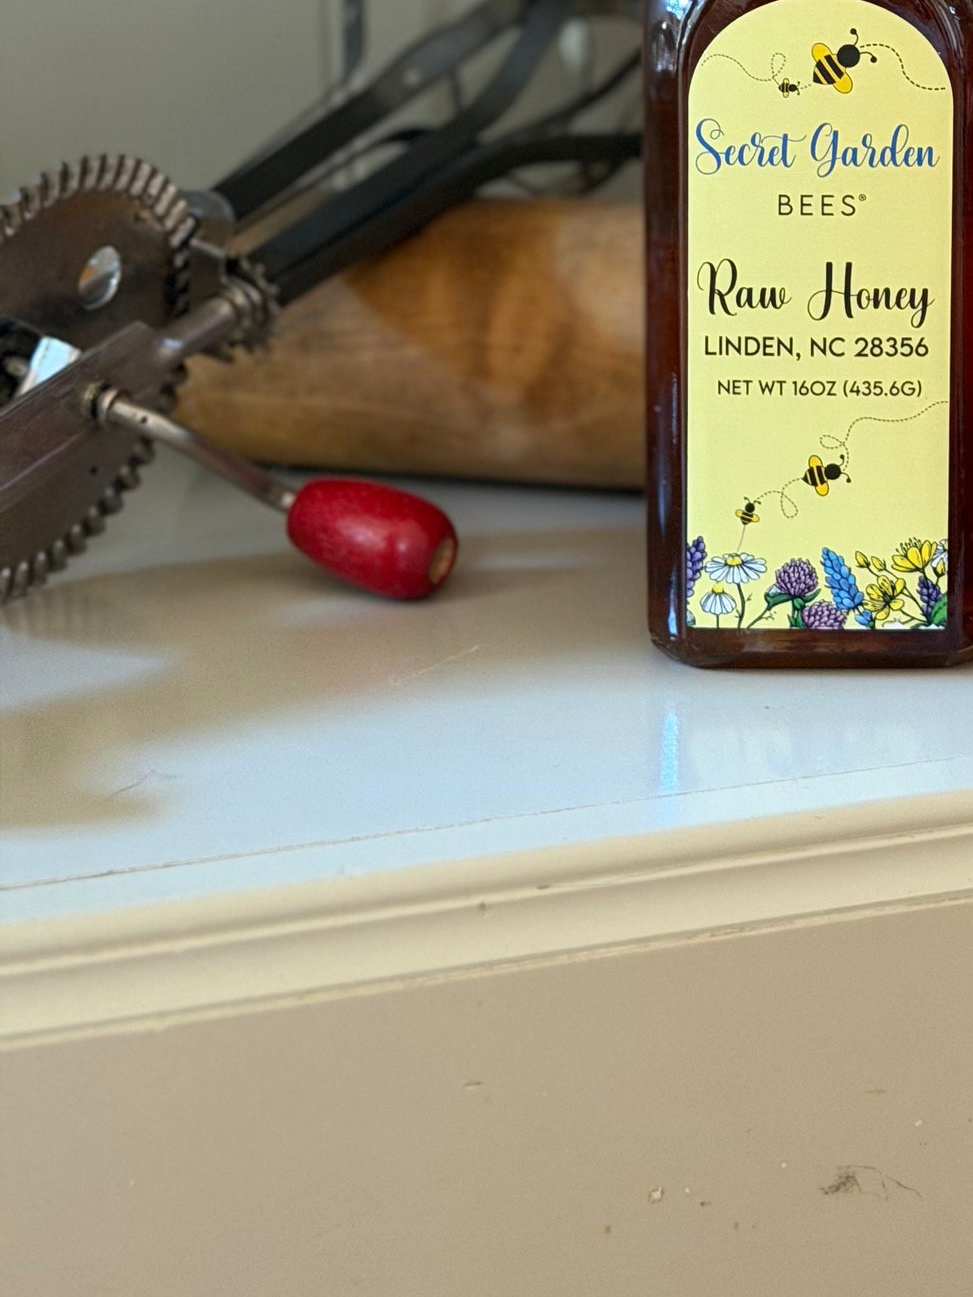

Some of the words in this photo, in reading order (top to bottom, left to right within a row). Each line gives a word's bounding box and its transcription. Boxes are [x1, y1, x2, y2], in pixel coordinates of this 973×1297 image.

[696, 118, 807, 176] Secret
[810, 122, 940, 178] Garden
[697, 258, 792, 316] Raw
[808, 262, 935, 328] Honey
[704, 335, 801, 361] LINDEN,
[810, 337, 845, 357] NC
[854, 337, 929, 357] 28356
[718, 379, 753, 395] NET
[758, 380, 787, 396] WT
[792, 380, 837, 396] 16OZ
[843, 380, 922, 398] (435.6G)
